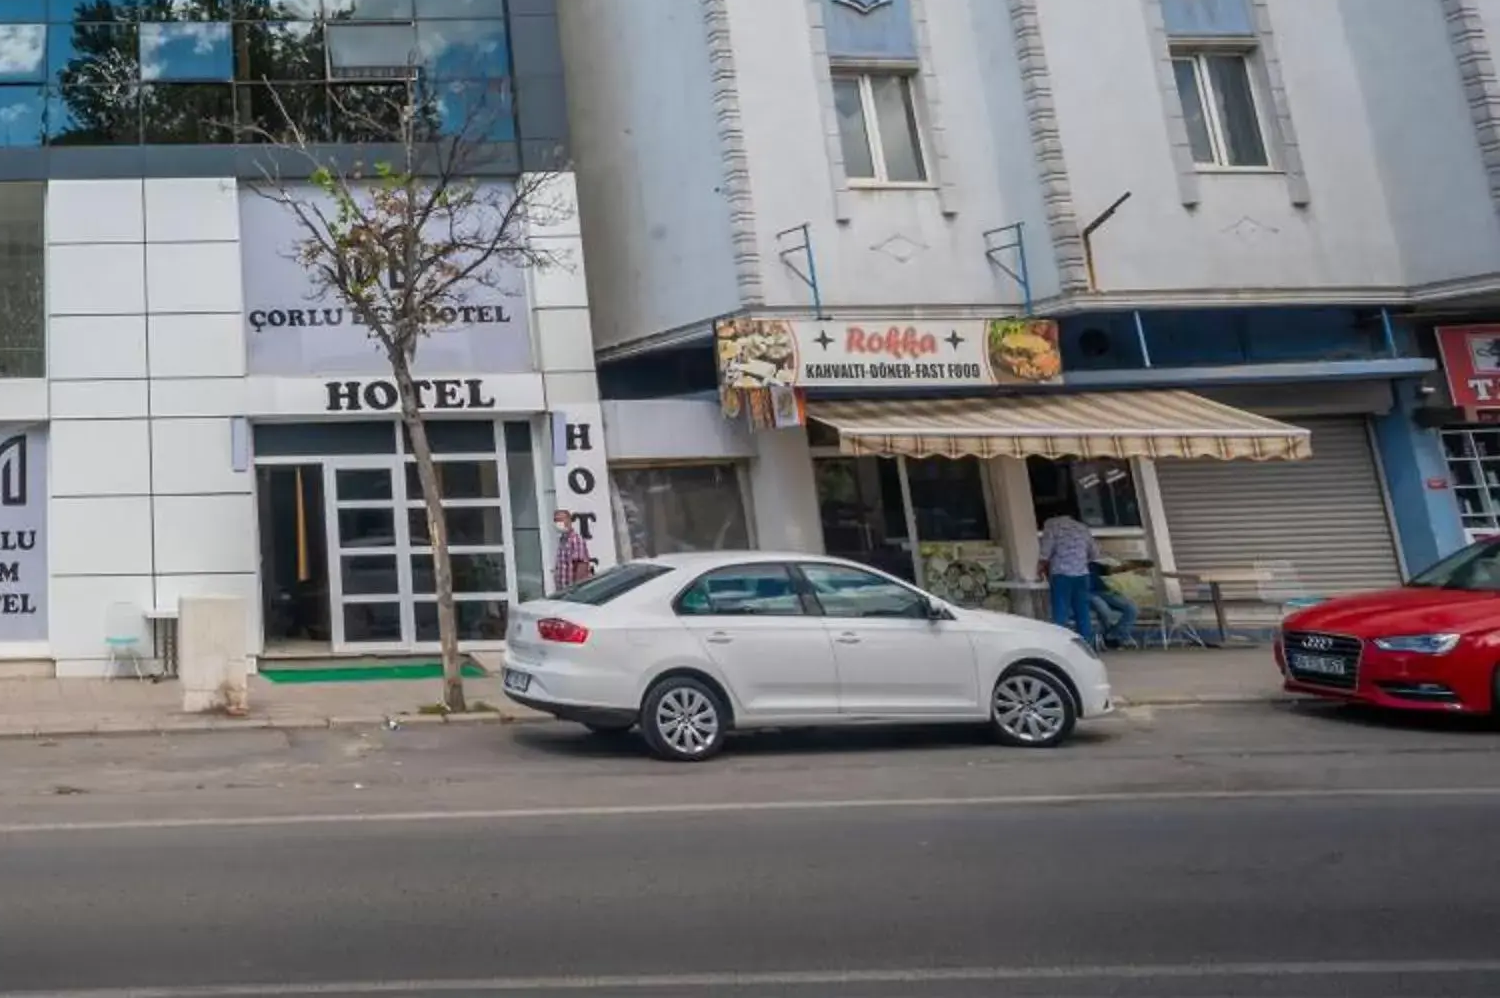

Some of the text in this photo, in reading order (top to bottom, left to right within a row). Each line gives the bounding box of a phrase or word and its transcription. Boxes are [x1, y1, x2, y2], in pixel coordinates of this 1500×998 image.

[249, 308, 343, 332] ÇORLU
[845, 325, 938, 359] Rokka
[948, 363, 981, 379] FOOD
[325, 379, 495, 410] HOTEL
